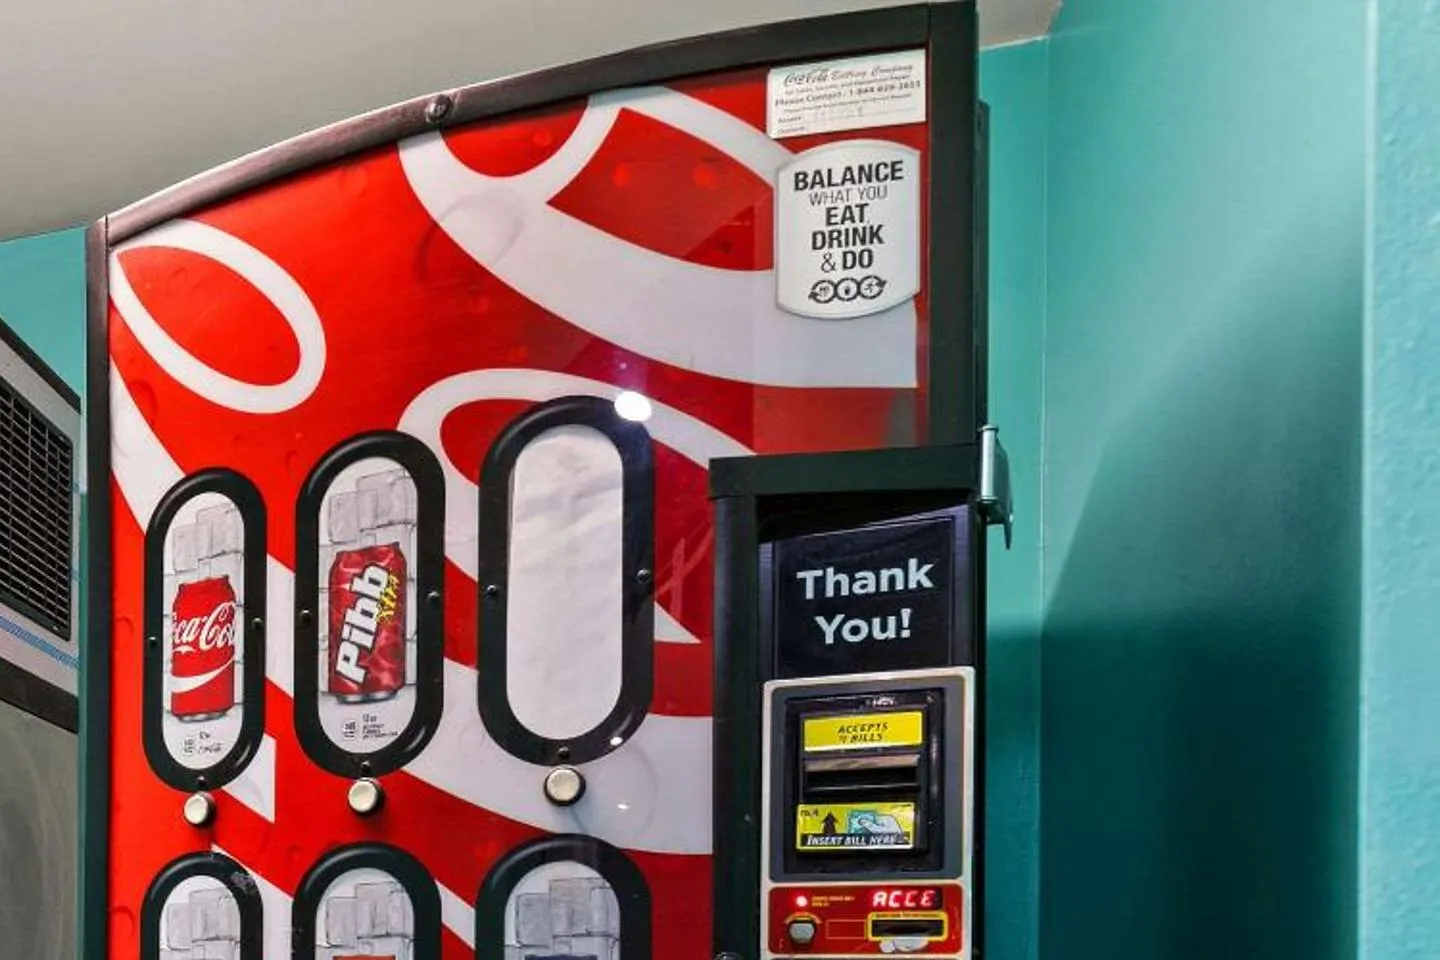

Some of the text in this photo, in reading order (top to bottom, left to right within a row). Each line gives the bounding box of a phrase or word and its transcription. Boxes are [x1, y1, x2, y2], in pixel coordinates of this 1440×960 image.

[793, 160, 905, 192] BALANCE
[809, 185, 888, 206] WHAT YOU
[825, 203, 870, 227] EAT
[811, 224, 884, 251] DRINK
[820, 249, 874, 273] & DO
[796, 558, 935, 600] Thank
[335, 564, 389, 684] Pibb
[814, 608, 913, 645] You!
[837, 721, 888, 734] ACCEPTS
[850, 732, 883, 743] BILLS
[806, 834, 843, 846] INSERT
[844, 833, 867, 845] BILL
[872, 890, 936, 908] ACCE
